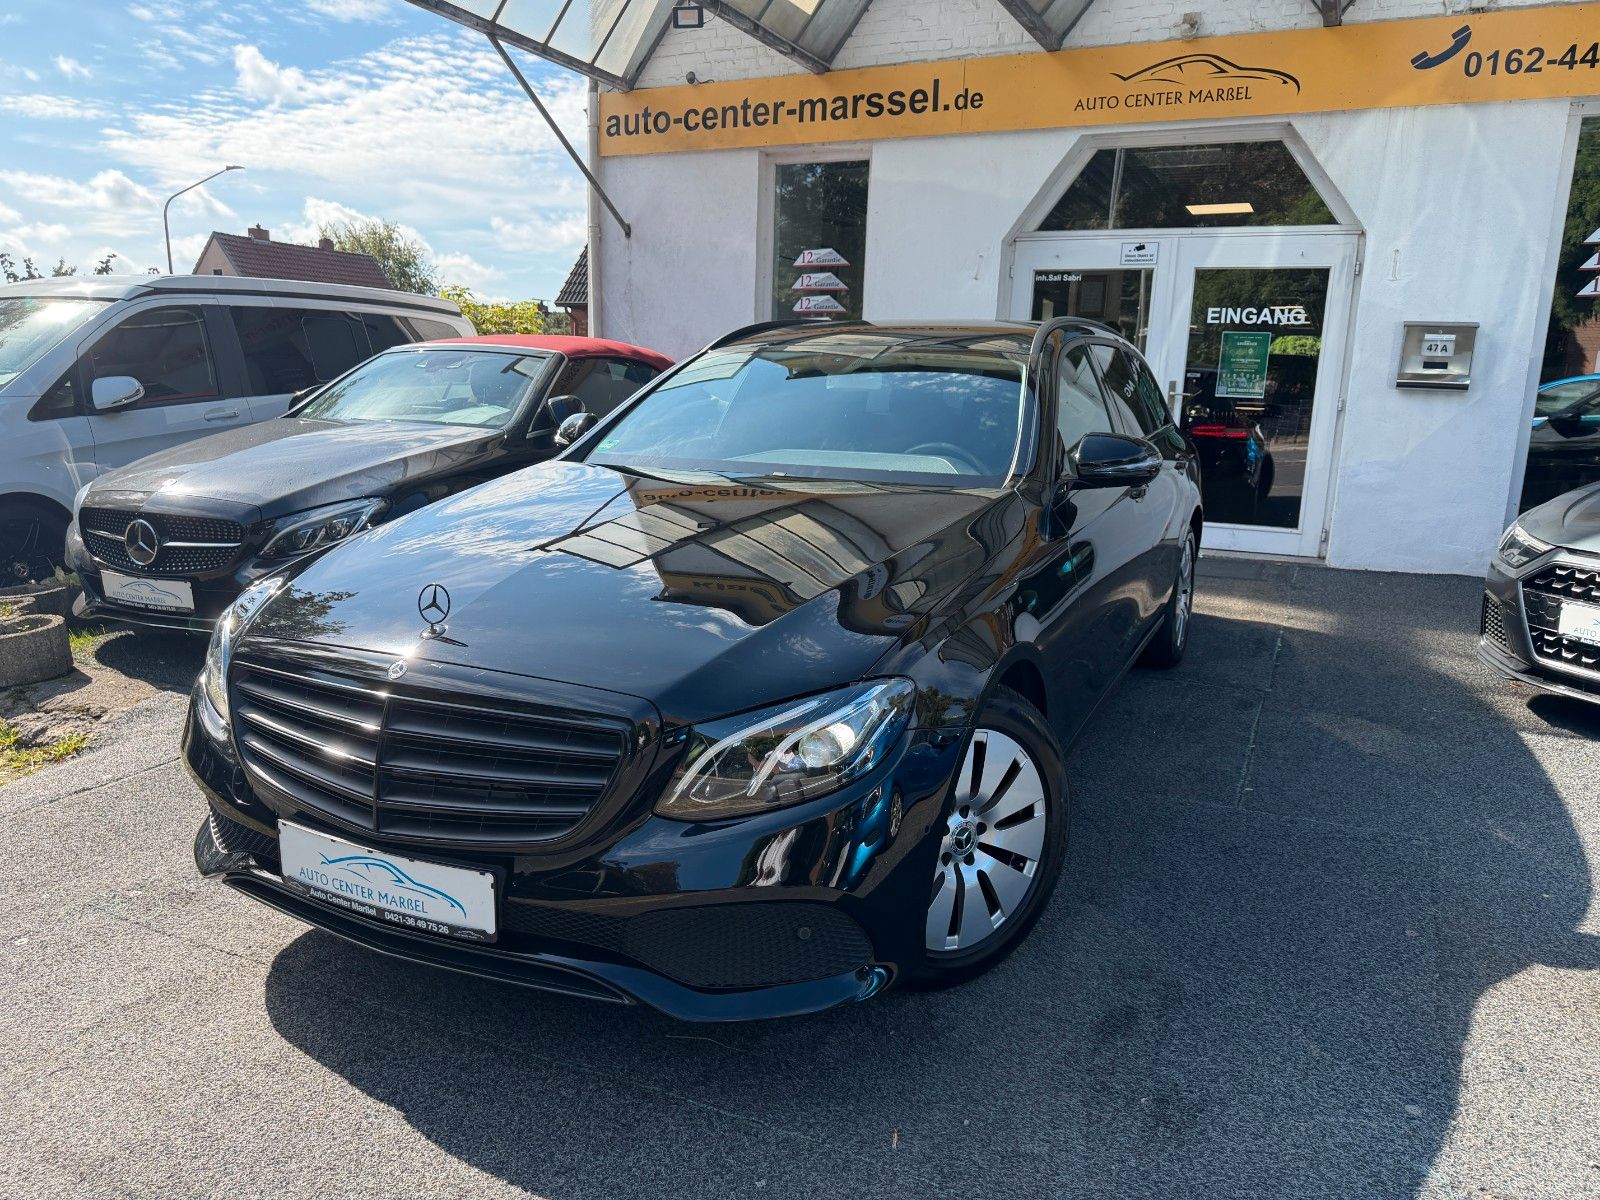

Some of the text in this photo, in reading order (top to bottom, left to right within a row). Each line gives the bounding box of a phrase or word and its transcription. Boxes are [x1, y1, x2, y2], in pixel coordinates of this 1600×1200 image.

[1463, 42, 1600, 77] 0162-44
[605, 78, 984, 138] auto-center-marssel.de
[1074, 95, 1119, 111] AUTO
[1124, 91, 1183, 108] CENTER
[802, 251, 813, 264] 12
[800, 275, 812, 287] 12
[799, 298, 811, 310] 12
[1206, 307, 1306, 325] EINGANG
[1426, 344, 1448, 353] 47 A
[1573, 627, 1597, 638] AUTO
[299, 867, 329, 886] AUTO
[331, 878, 375, 901] CENTER
[310, 887, 326, 900] Auto
[327, 893, 350, 907] Center
[384, 911, 416, 926] 0421-36
[416, 919, 427, 929] 49
[427, 921, 438, 932] 75
[438, 924, 449, 934] 26
